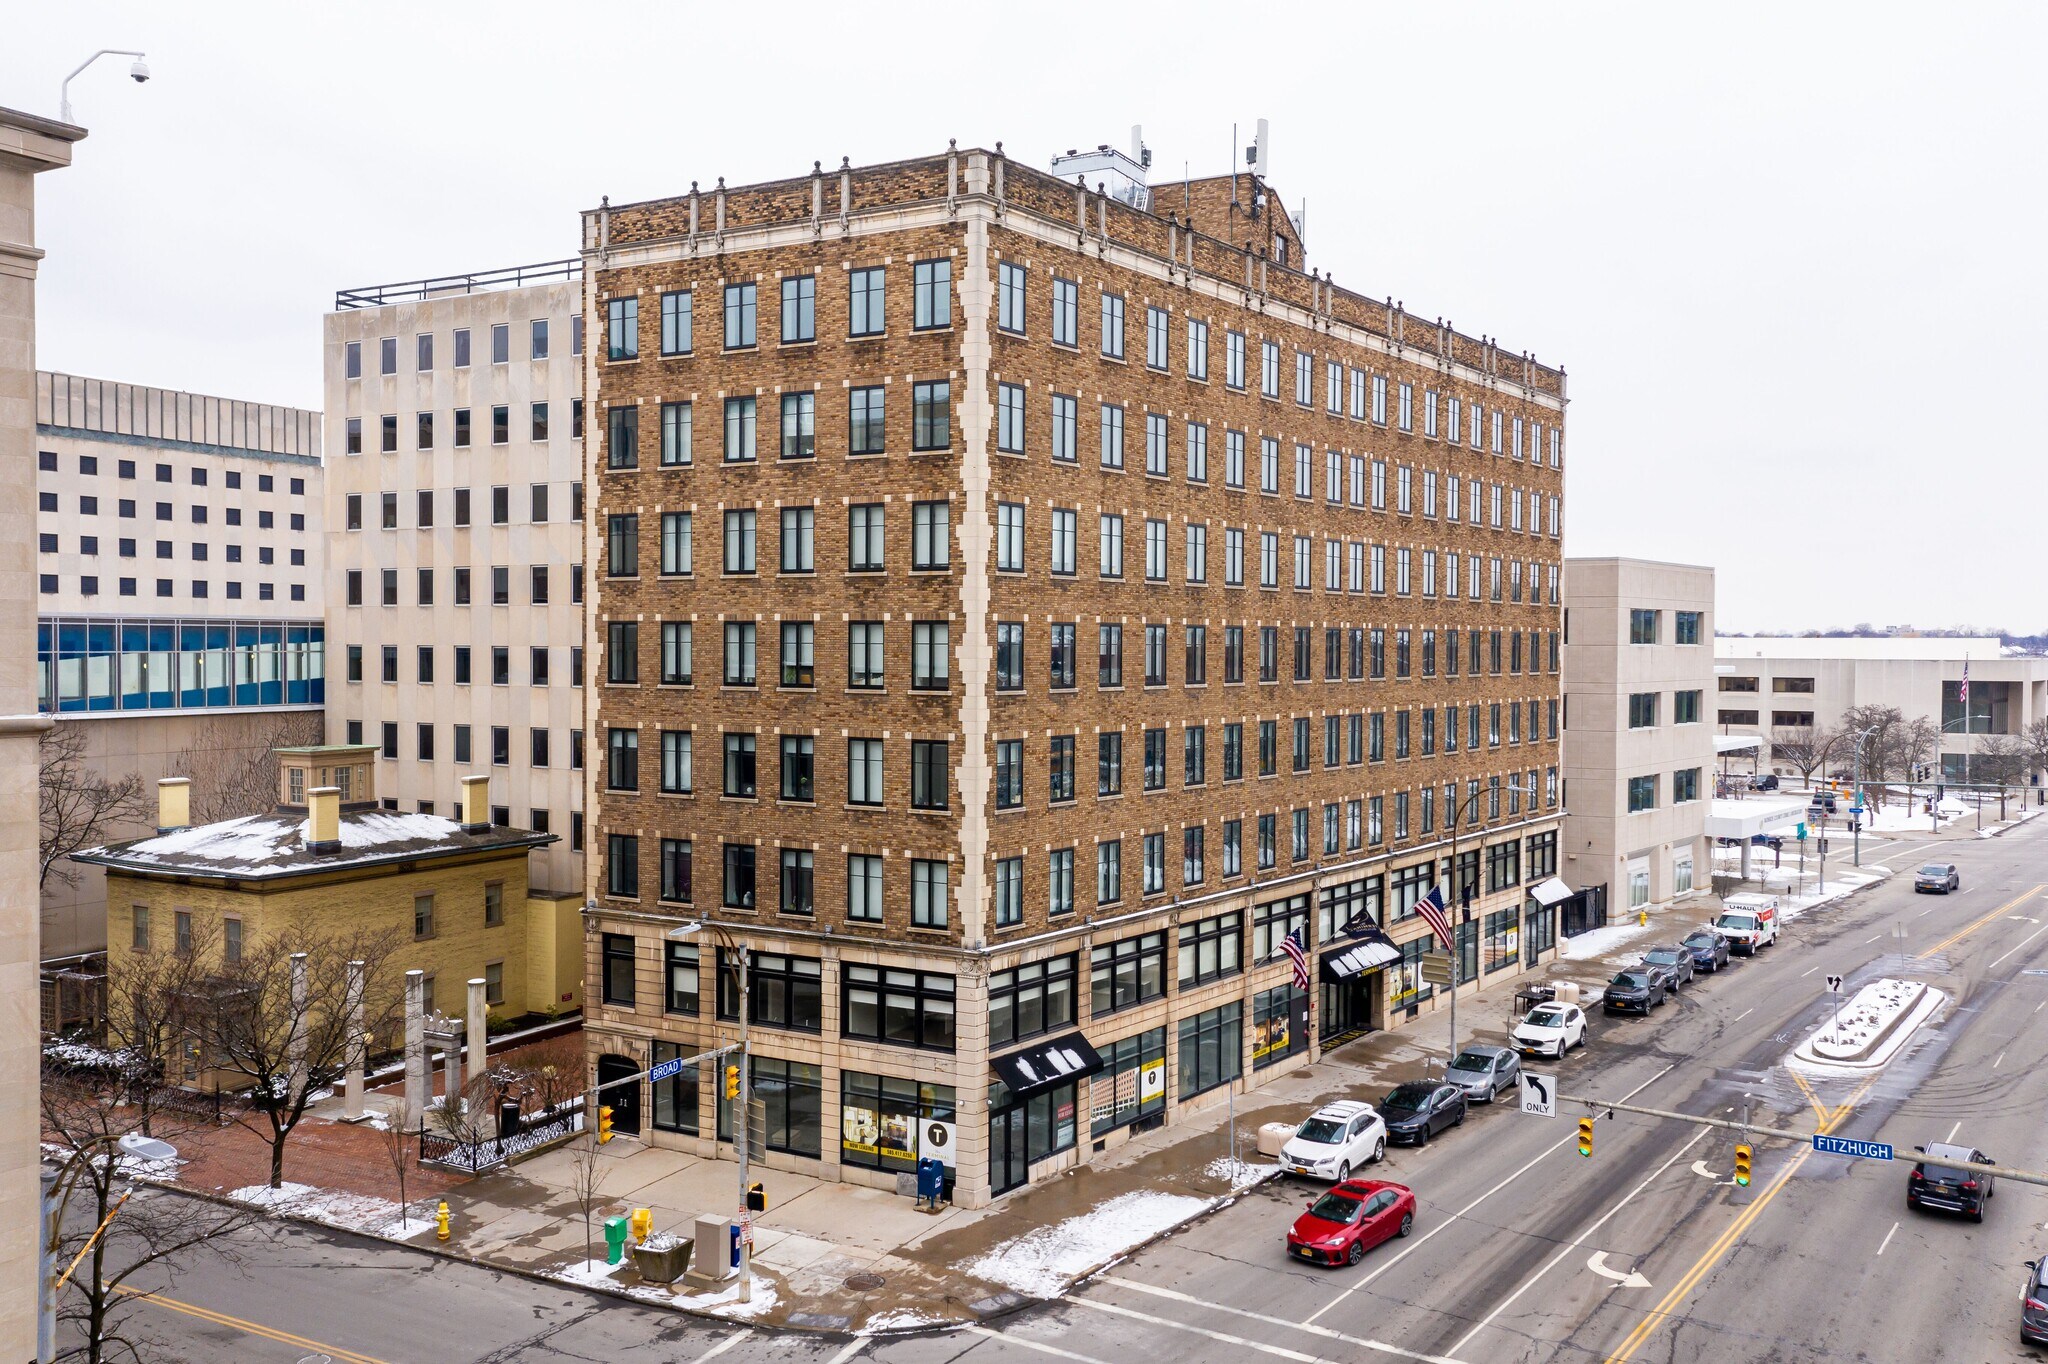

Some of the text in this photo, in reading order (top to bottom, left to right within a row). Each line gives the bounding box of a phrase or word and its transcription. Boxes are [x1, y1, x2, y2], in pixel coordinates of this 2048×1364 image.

[653, 1061, 679, 1080] BROAD
[1526, 1102, 1549, 1113] ONLY
[933, 1128, 943, 1143] T
[849, 1142, 859, 1150] NOW
[1817, 1137, 1889, 1159] FITZHUGH
[925, 1152, 950, 1161] TERMINAL
